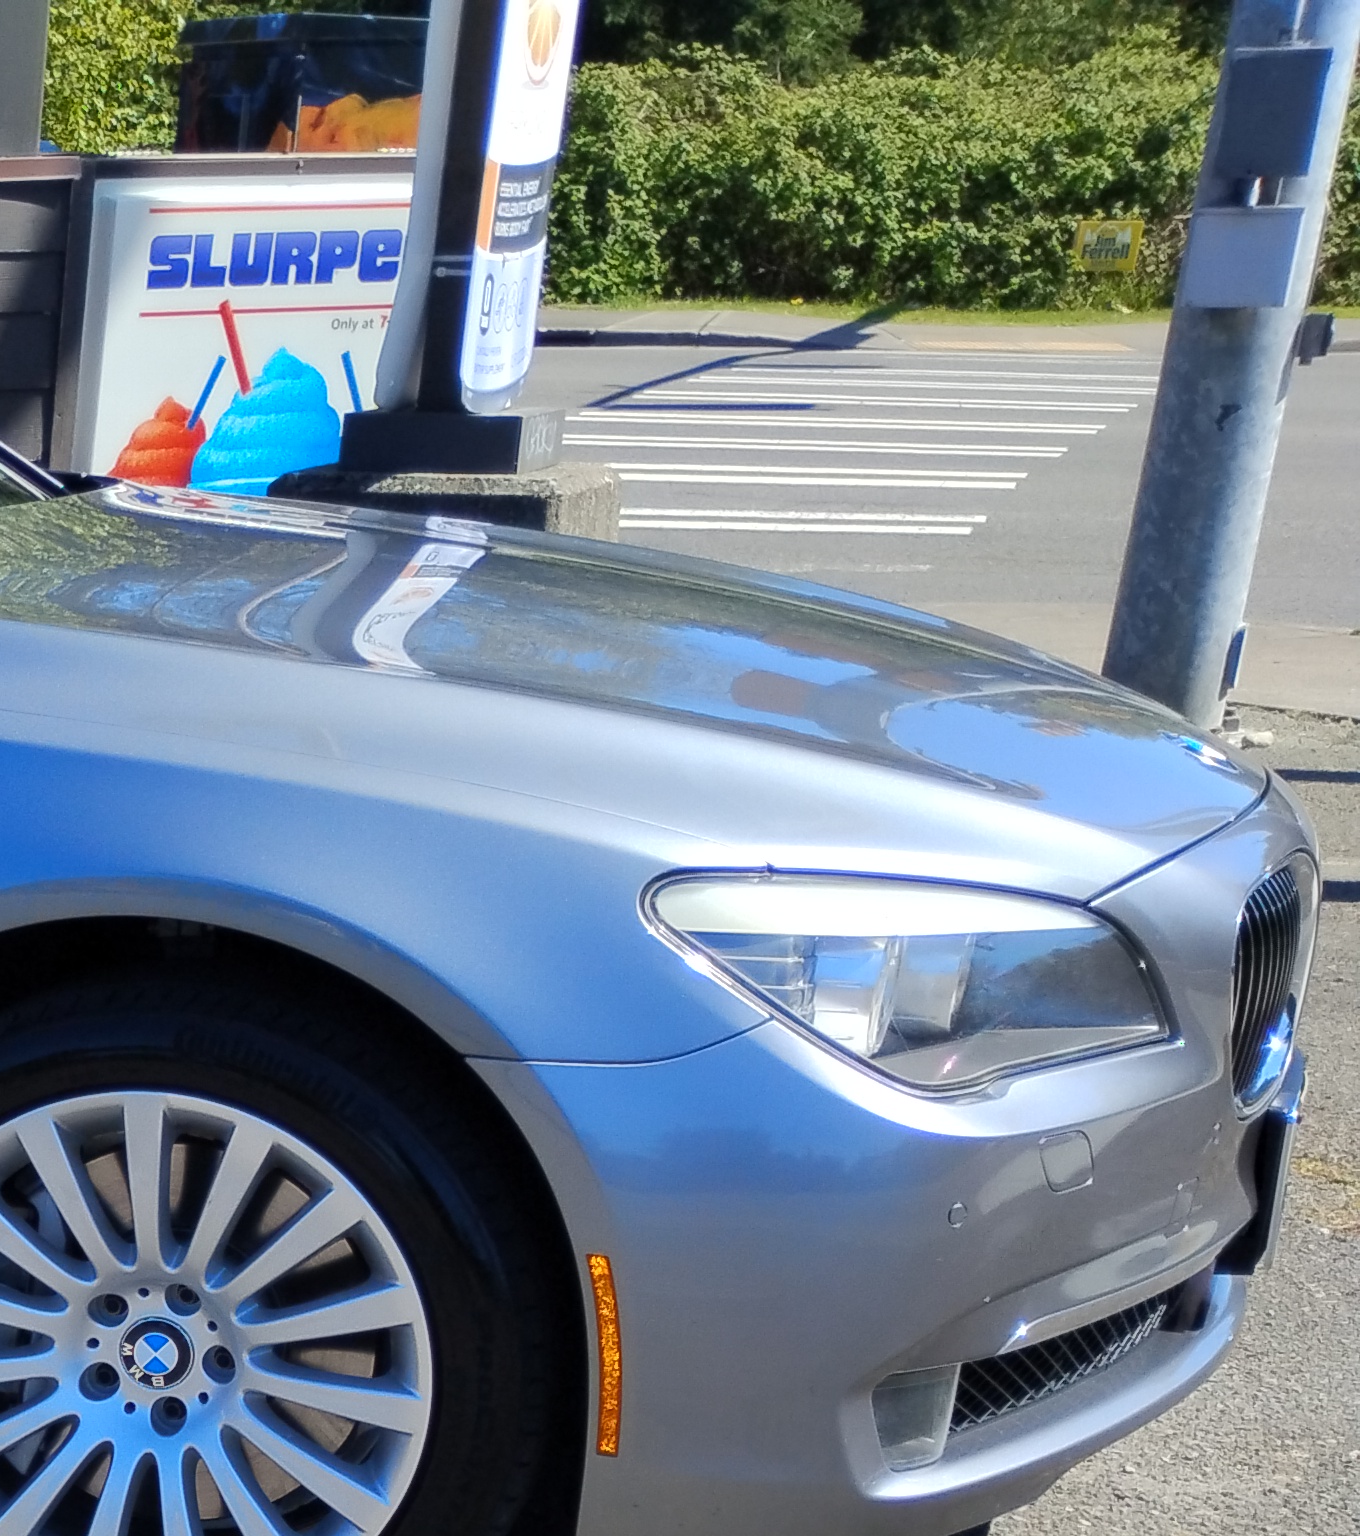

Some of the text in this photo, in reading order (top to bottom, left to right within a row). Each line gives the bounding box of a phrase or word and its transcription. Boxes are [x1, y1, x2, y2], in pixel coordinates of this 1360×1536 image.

[1081, 243, 1130, 259] Ferrell
[146, 229, 403, 290] SLURPe
[331, 317, 359, 332] Only
[362, 318, 374, 329] at
